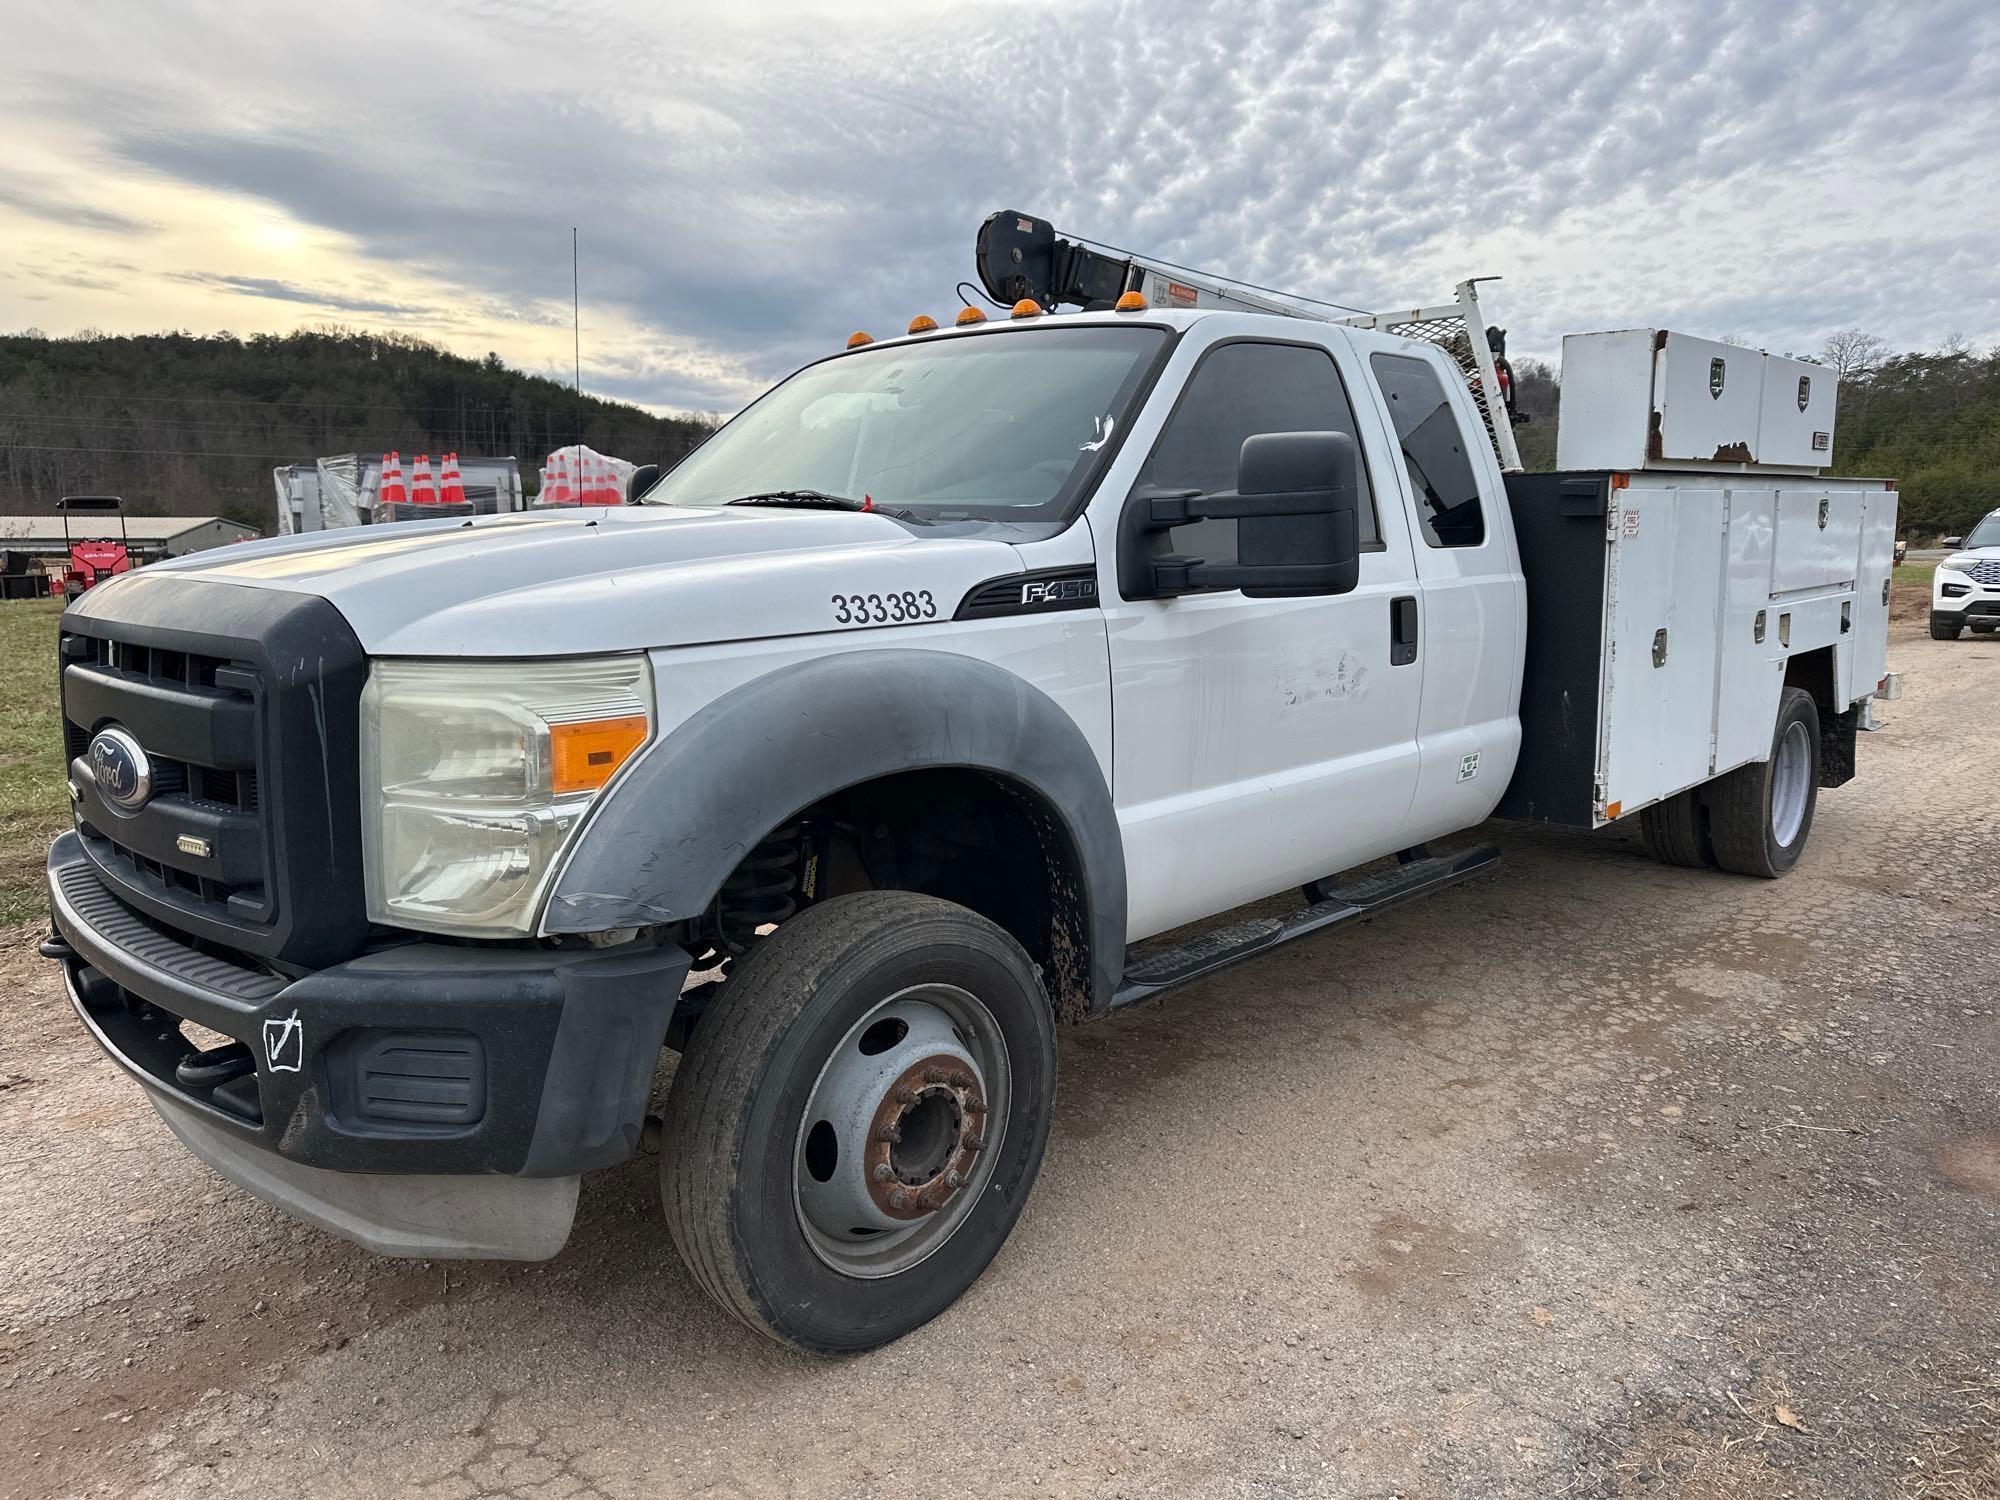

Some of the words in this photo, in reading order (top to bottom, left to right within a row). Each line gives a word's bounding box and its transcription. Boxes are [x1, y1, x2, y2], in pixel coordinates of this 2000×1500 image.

[831, 589, 937, 624] 333383
[1021, 578, 1097, 605] F-450
[93, 741, 123, 789] Ford
[806, 854, 819, 900] MONROE
